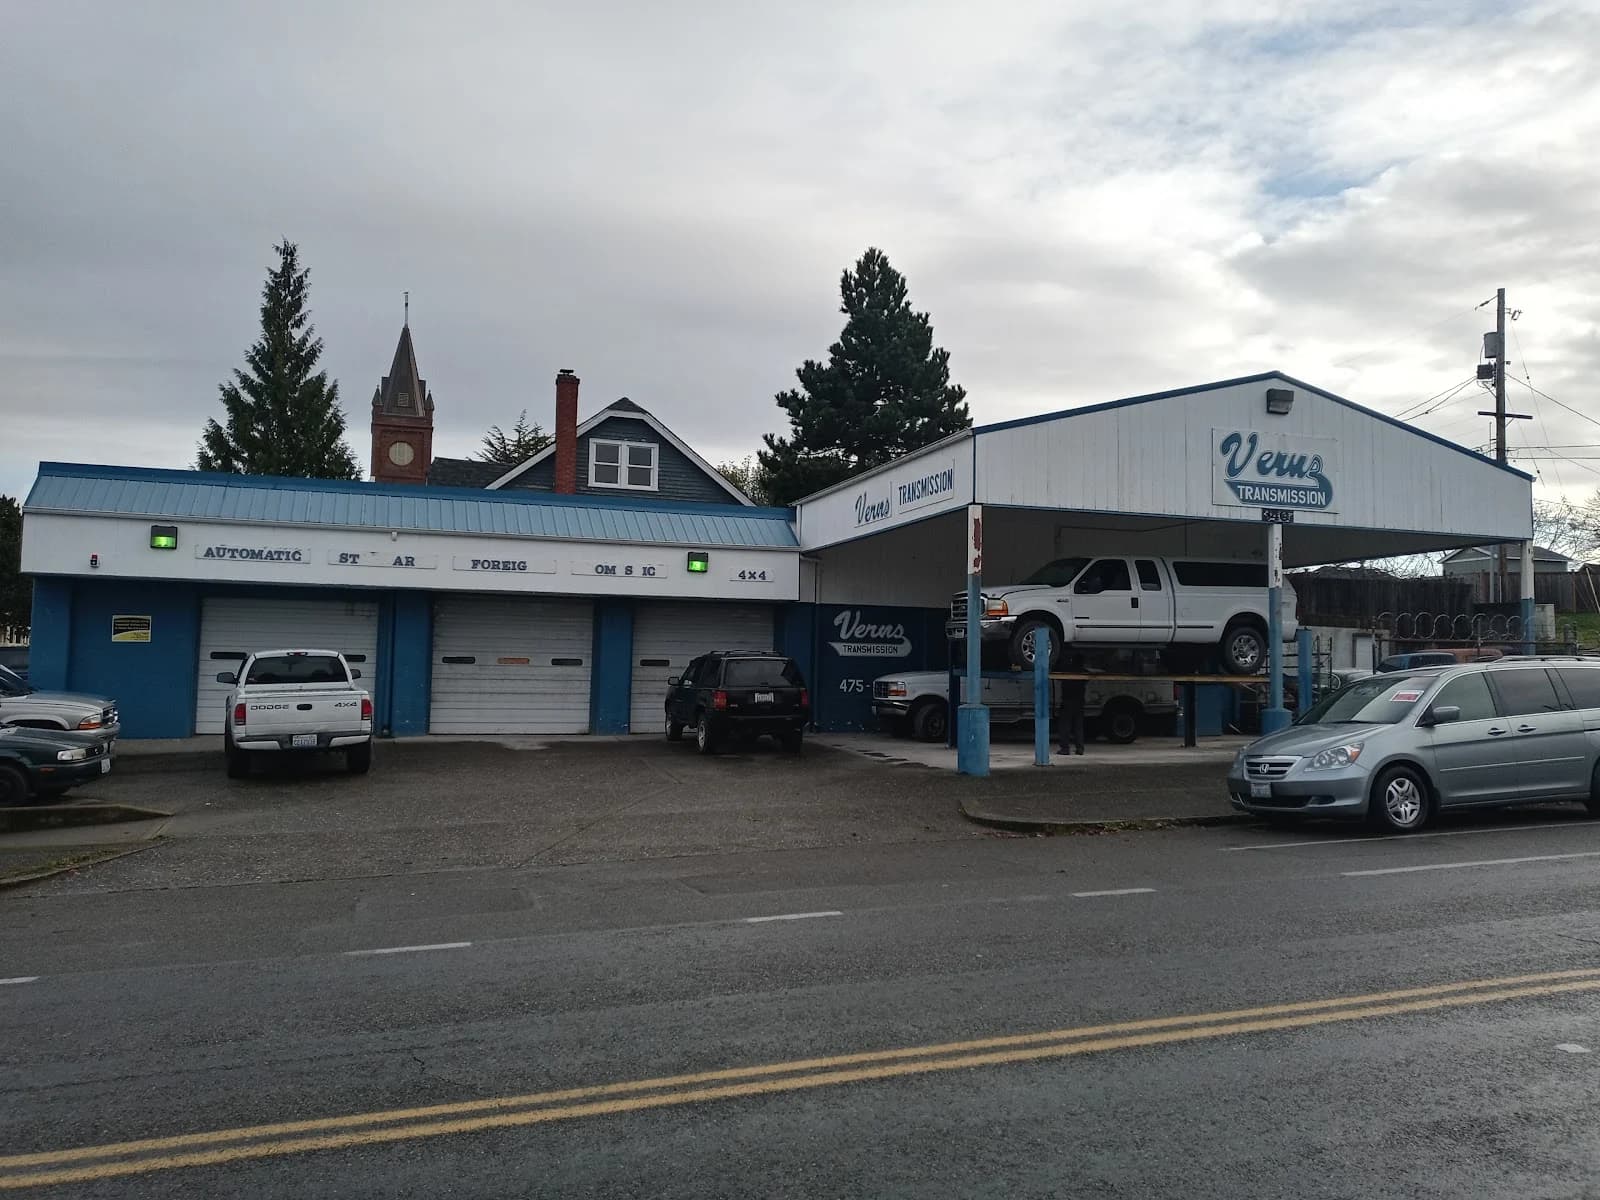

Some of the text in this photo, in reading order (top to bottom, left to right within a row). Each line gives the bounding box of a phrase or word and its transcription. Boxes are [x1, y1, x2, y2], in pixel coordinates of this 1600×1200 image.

[1221, 432, 1324, 479] Verns
[855, 468, 953, 524] Verns TRANSMISSION
[1237, 485, 1326, 505] TRANSMISSION
[203, 546, 302, 562] AUTOMATIC
[471, 559, 527, 571] FOREIG
[834, 610, 904, 640] Verns
[843, 644, 898, 654] TRANSMISSION
